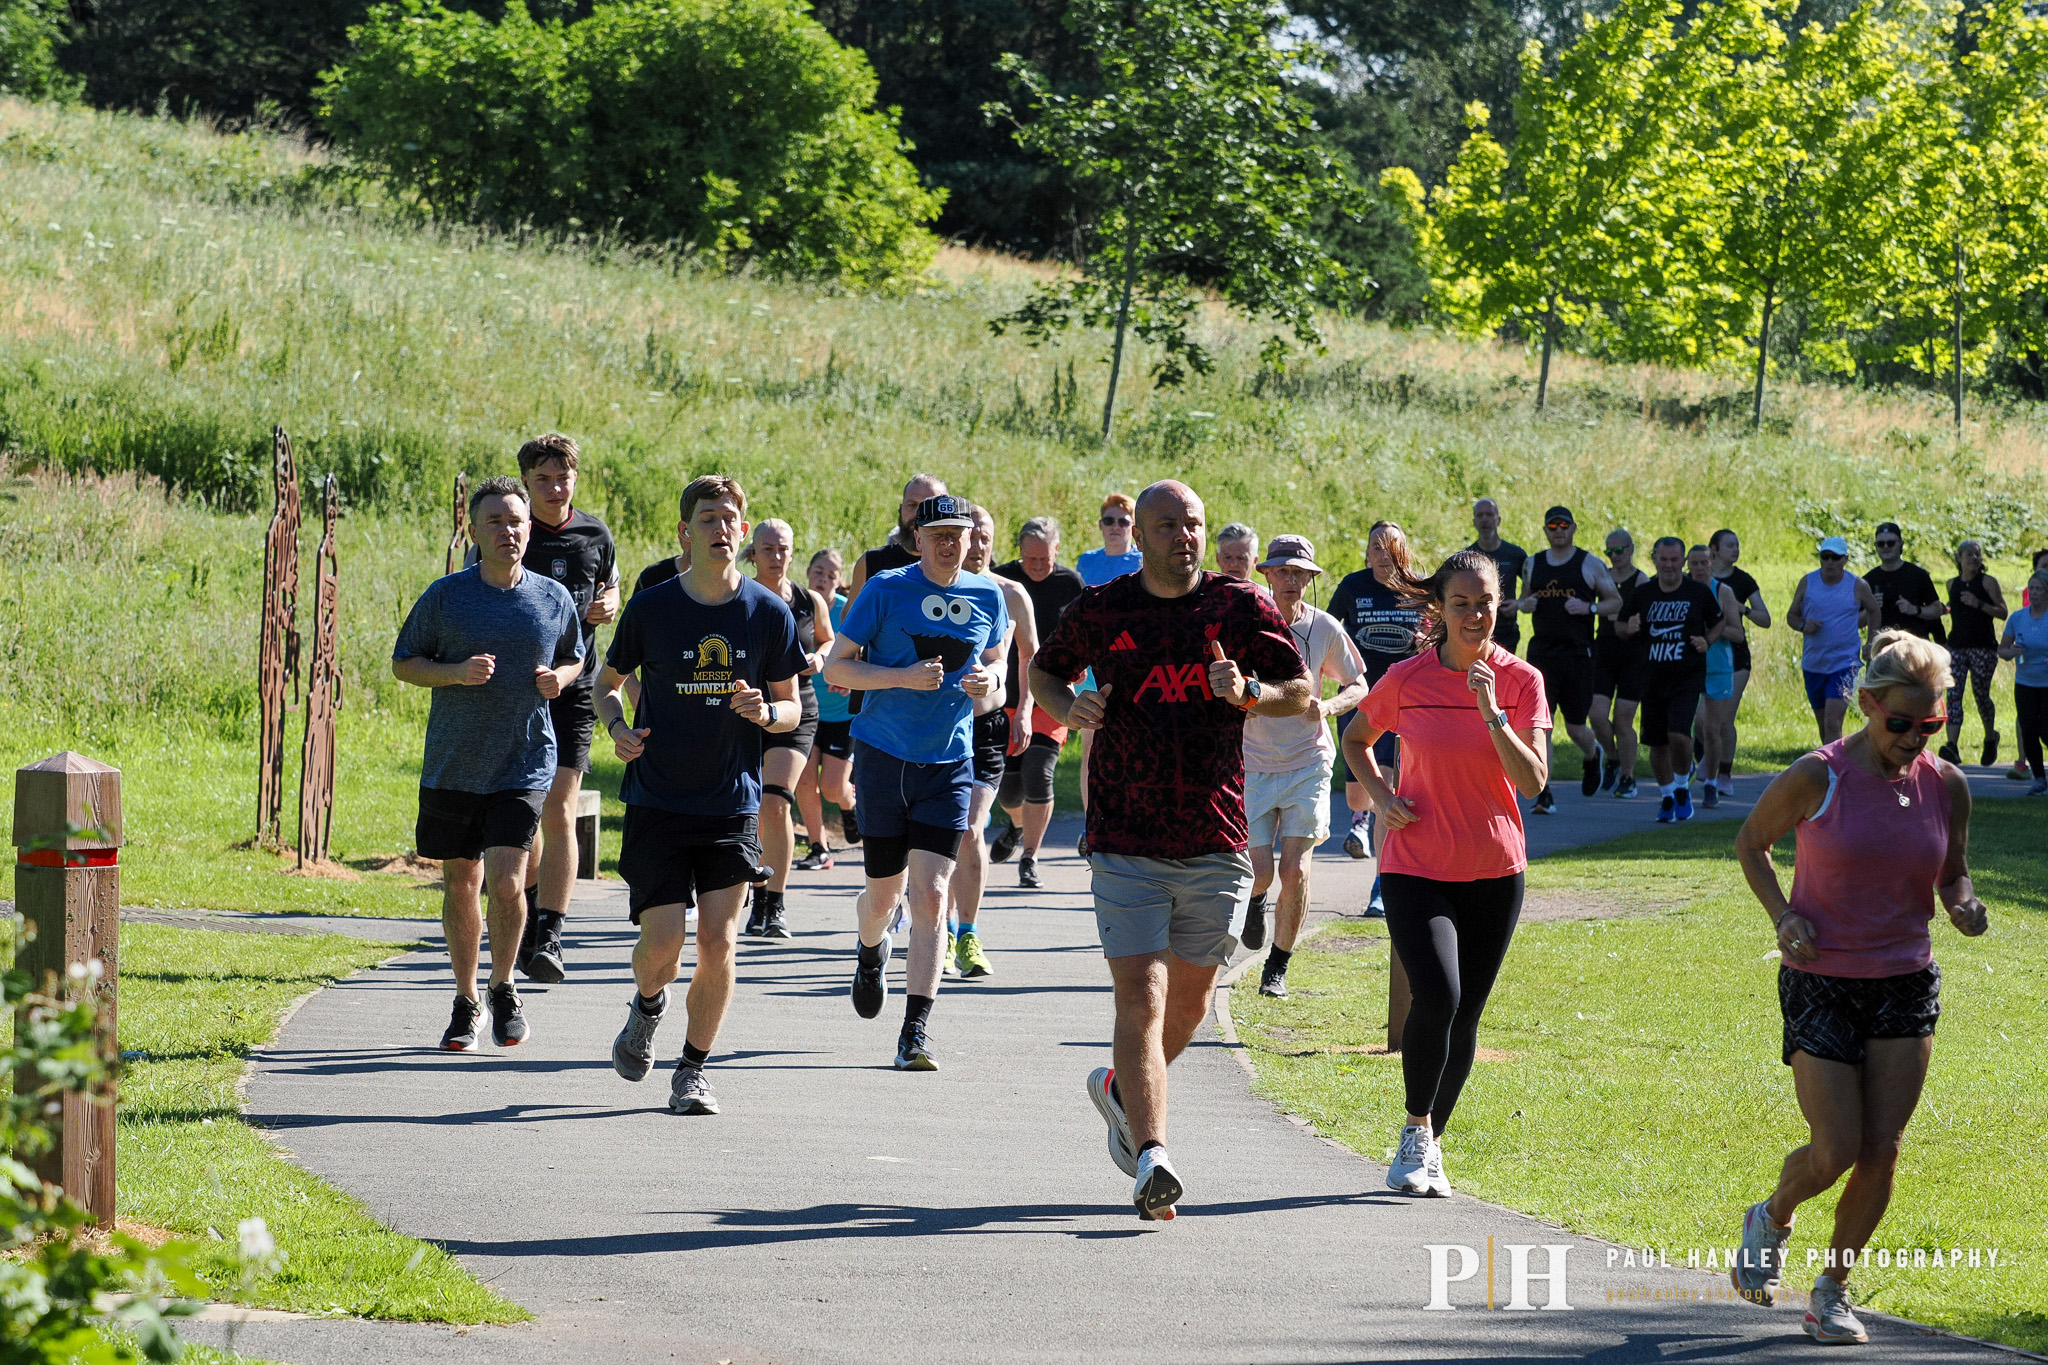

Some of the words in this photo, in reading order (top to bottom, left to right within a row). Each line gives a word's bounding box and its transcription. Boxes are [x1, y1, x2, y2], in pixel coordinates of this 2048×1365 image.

[940, 503, 953, 511] 66
[1647, 601, 1690, 622] NIKE
[1662, 632, 1682, 640] AIR
[683, 651, 694, 659] 20
[736, 650, 746, 658] 26
[1649, 642, 1685, 662] NIKE
[693, 671, 733, 681] MERSEY
[1133, 663, 1213, 703] AXA
